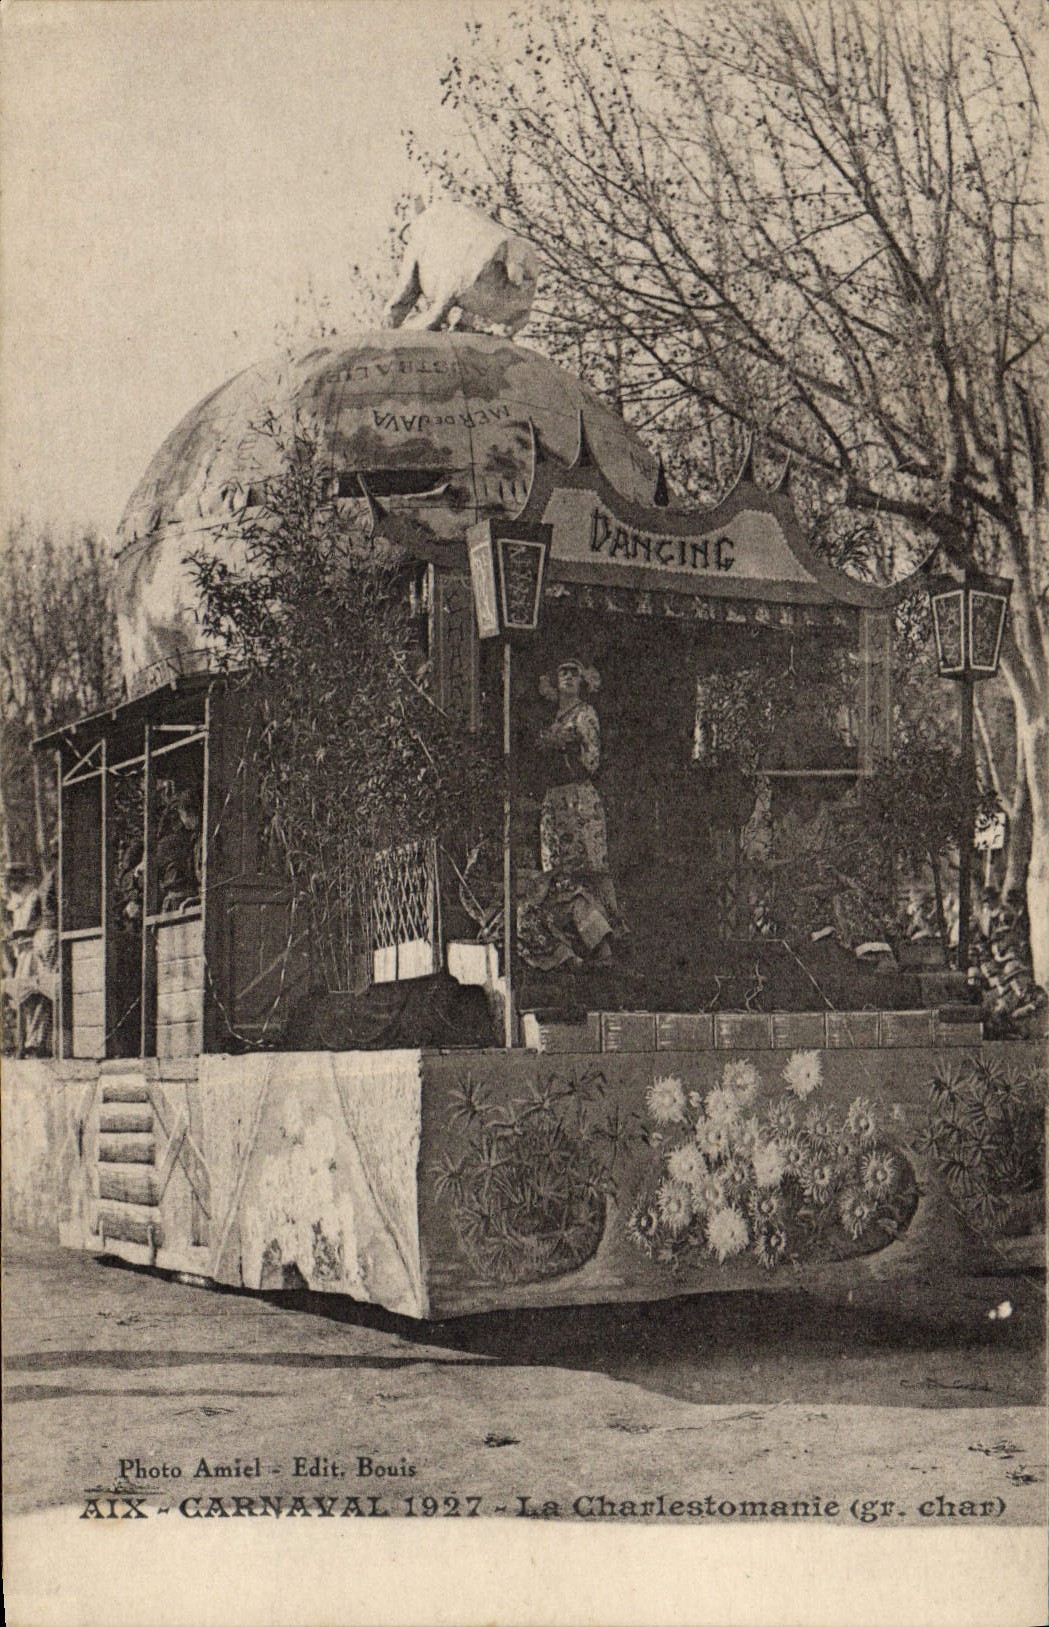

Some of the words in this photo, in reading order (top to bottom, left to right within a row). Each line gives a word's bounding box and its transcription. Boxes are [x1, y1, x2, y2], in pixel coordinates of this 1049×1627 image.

[373, 409, 429, 432] JAVA
[435, 415, 454, 425] DE
[459, 404, 510, 428] MER
[589, 507, 735, 571] DANCING
